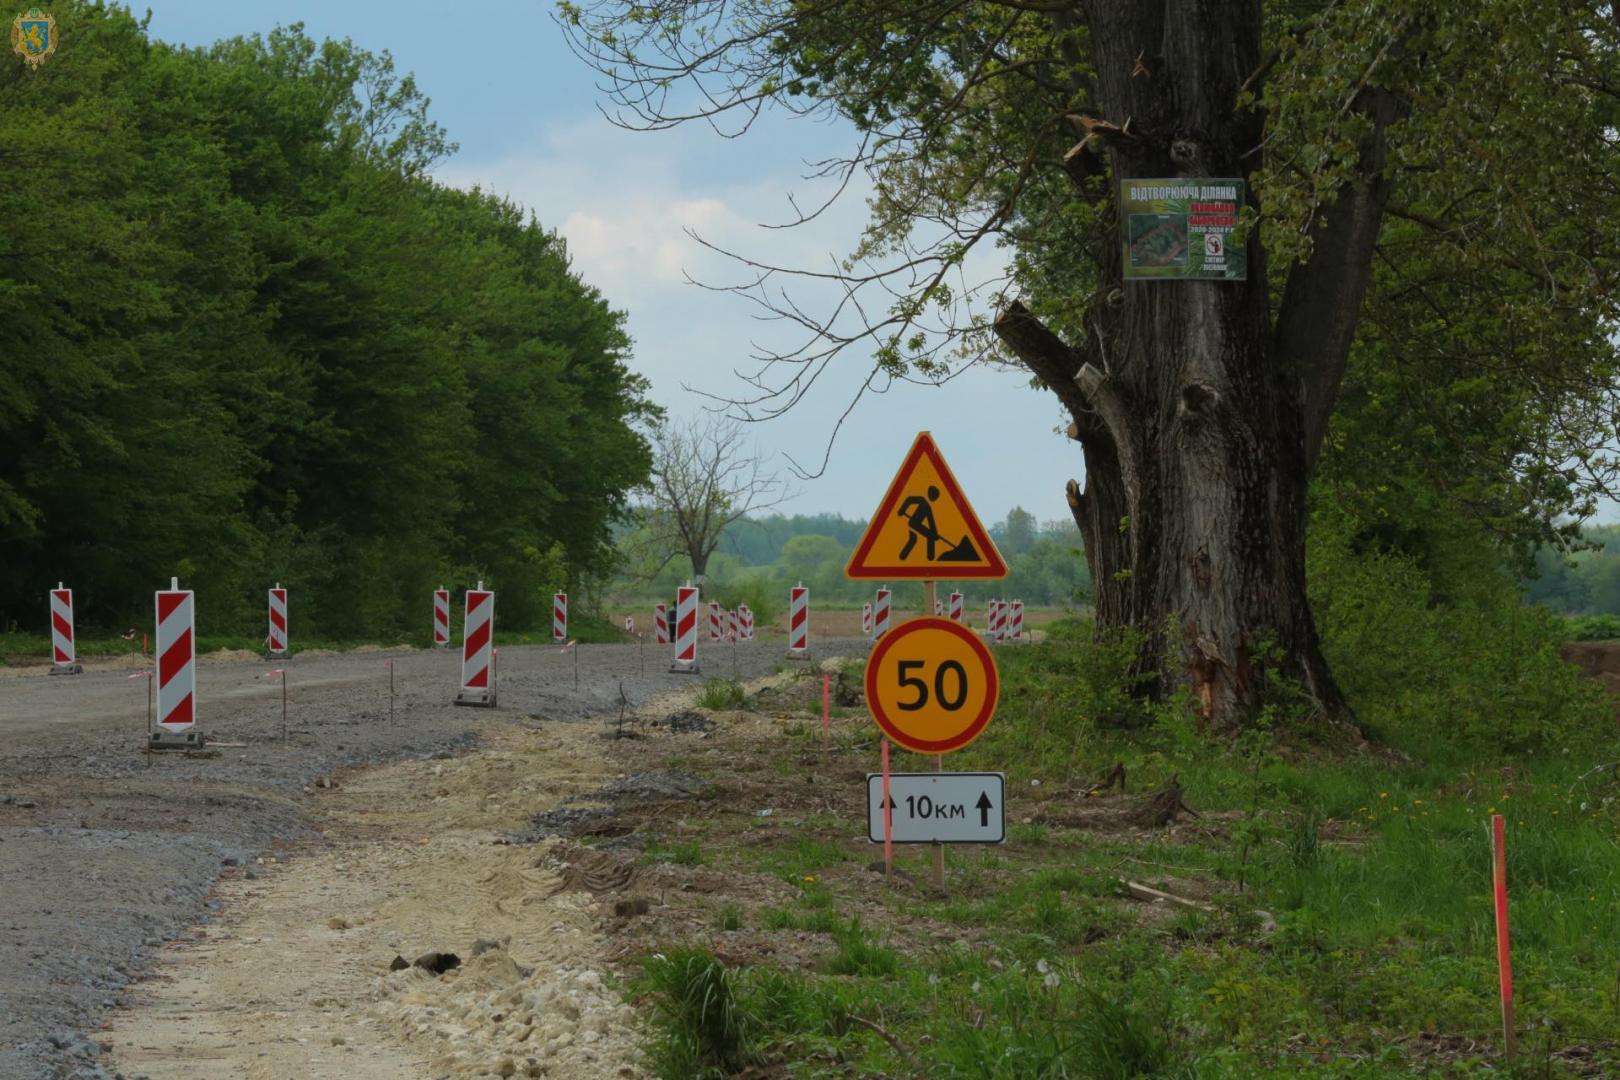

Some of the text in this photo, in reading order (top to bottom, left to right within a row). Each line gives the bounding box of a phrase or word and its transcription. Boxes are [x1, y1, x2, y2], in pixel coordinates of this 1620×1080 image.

[1130, 186, 1237, 201] ВІДТВОРЮЮЧА ДІЛЯНКА
[897, 659, 968, 712] 50
